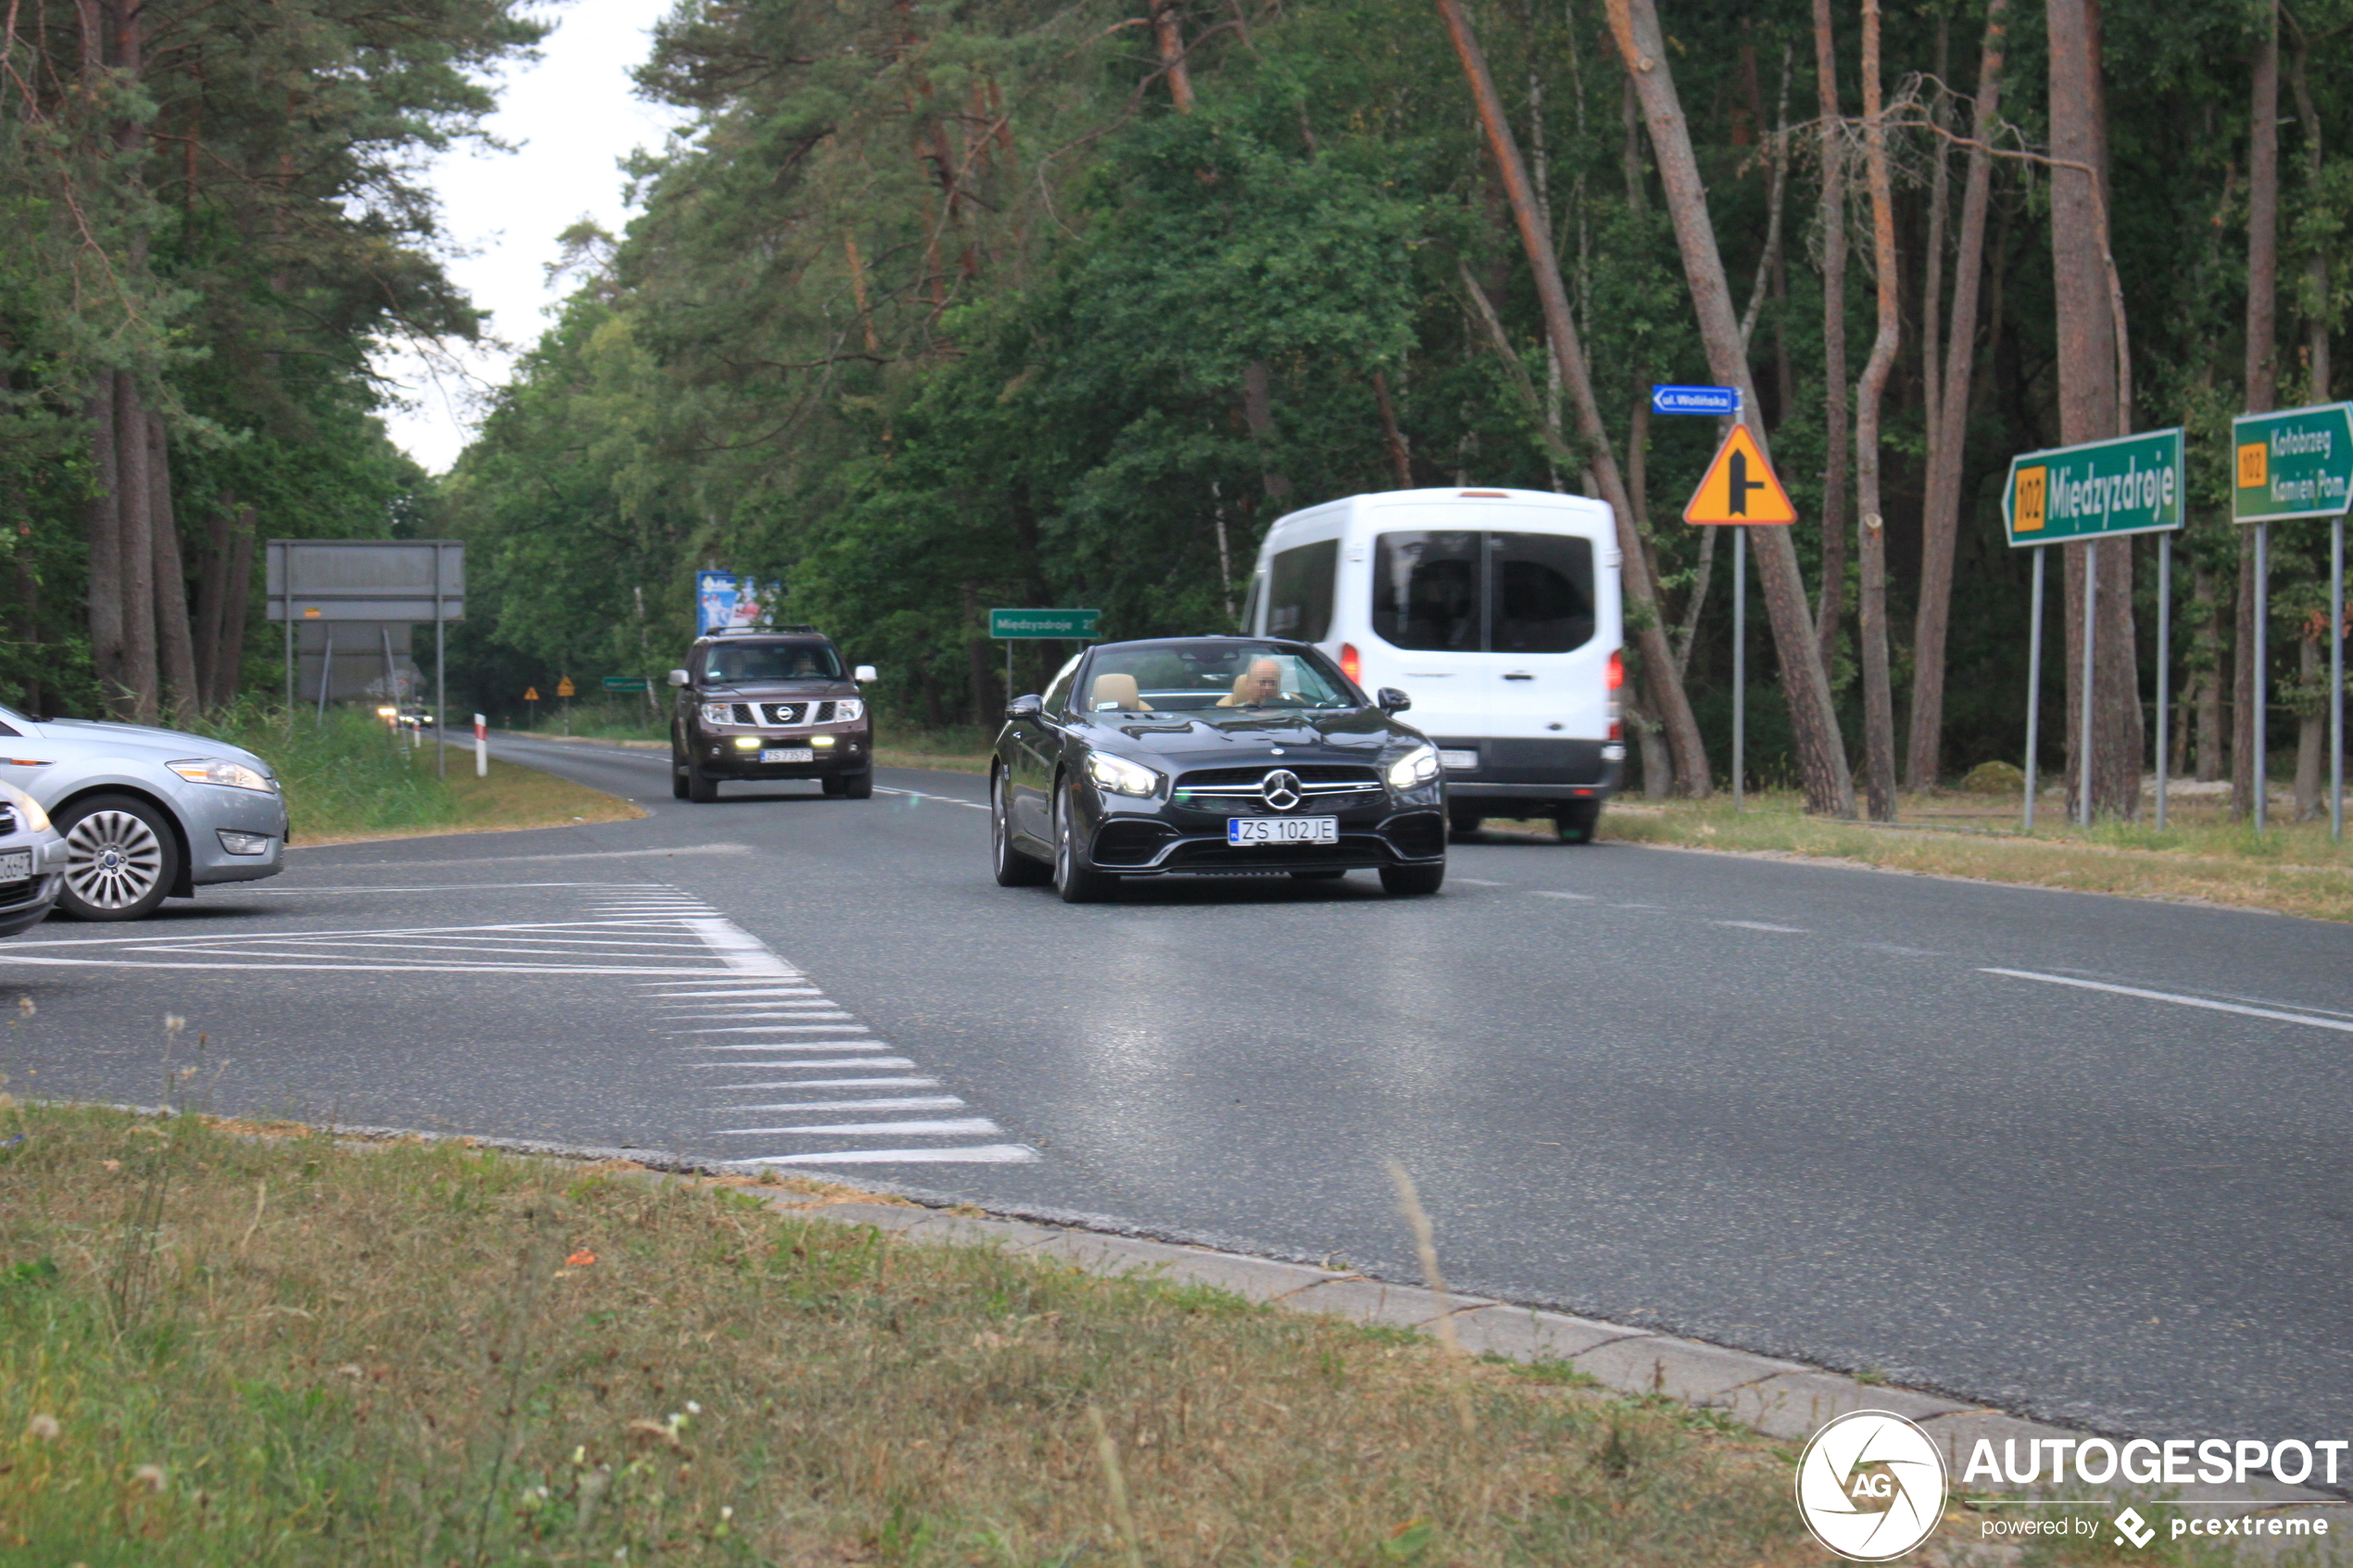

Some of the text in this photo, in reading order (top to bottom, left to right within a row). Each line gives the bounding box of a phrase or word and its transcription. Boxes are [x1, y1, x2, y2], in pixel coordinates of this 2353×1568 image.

[2271, 425, 2332, 459] Kołobrzeg
[2019, 476, 2042, 521] 102
[2048, 450, 2174, 532] Międzyzdroje
[1242, 821, 1332, 839] ZS 102JE
